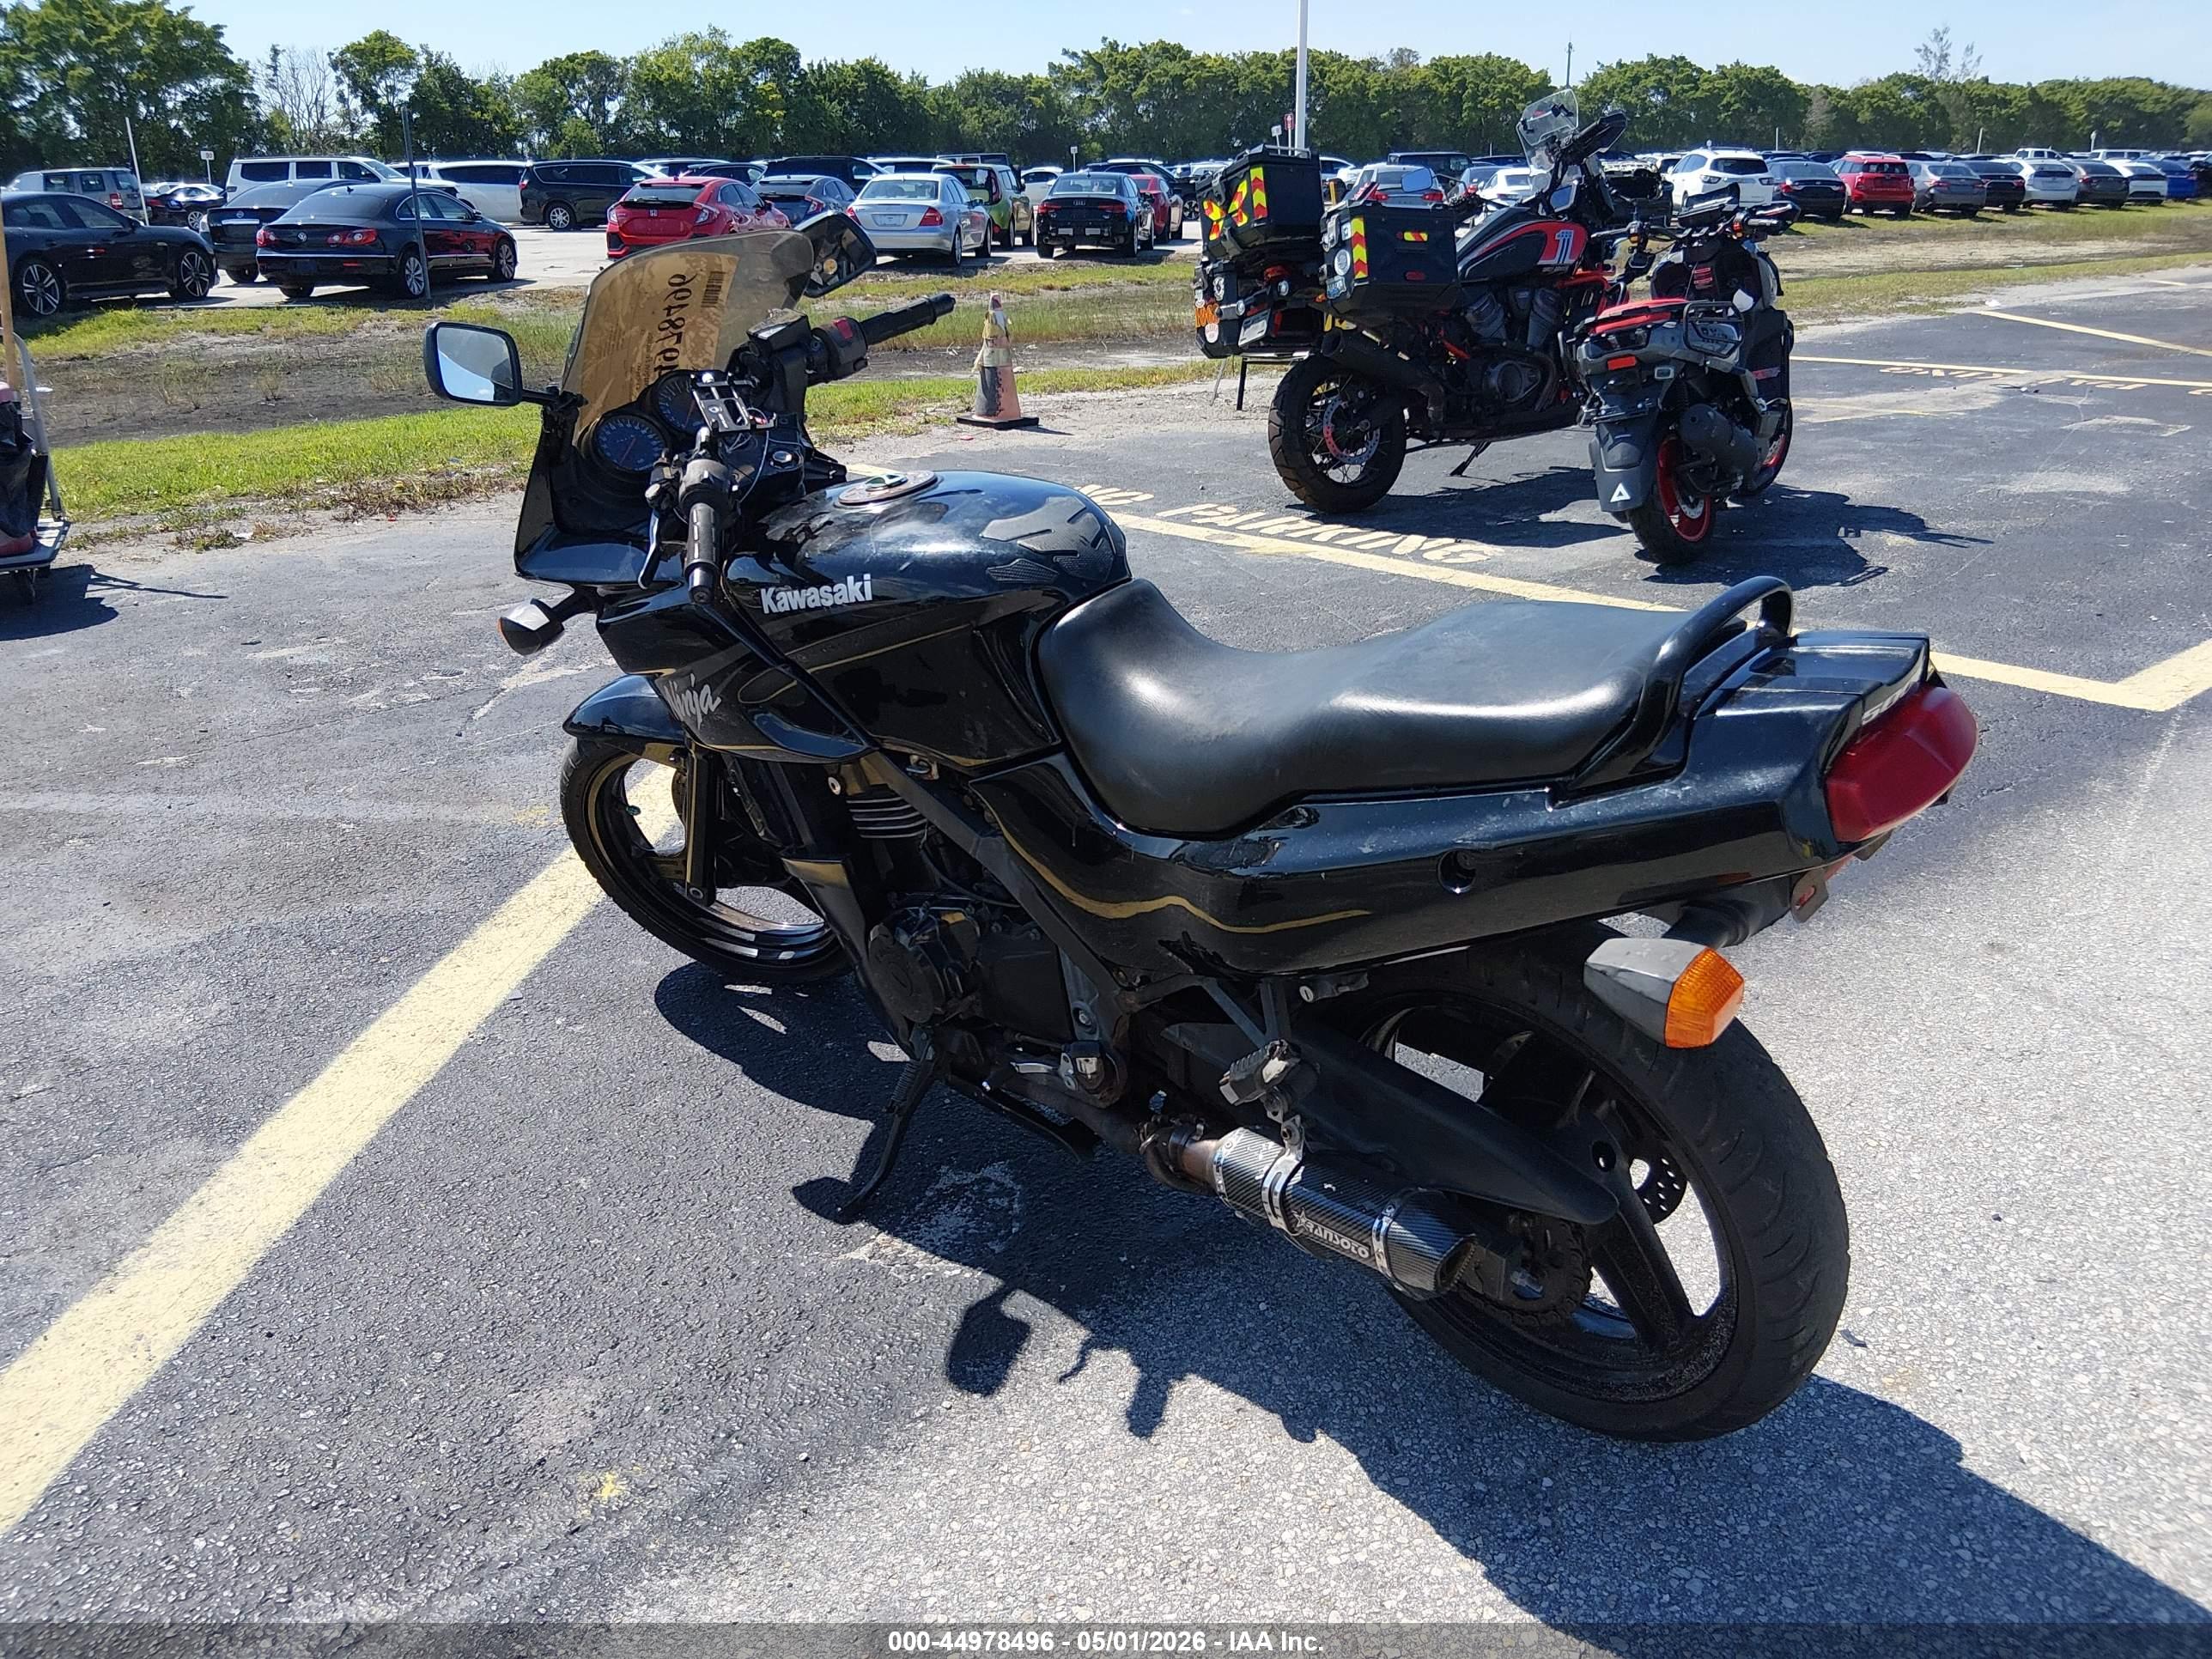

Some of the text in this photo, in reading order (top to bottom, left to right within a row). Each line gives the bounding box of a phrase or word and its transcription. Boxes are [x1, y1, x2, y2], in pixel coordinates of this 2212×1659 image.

[1155, 503, 1505, 563] PARKING
[760, 573, 873, 614] Kawasaki
[664, 672, 722, 730] Ninja
